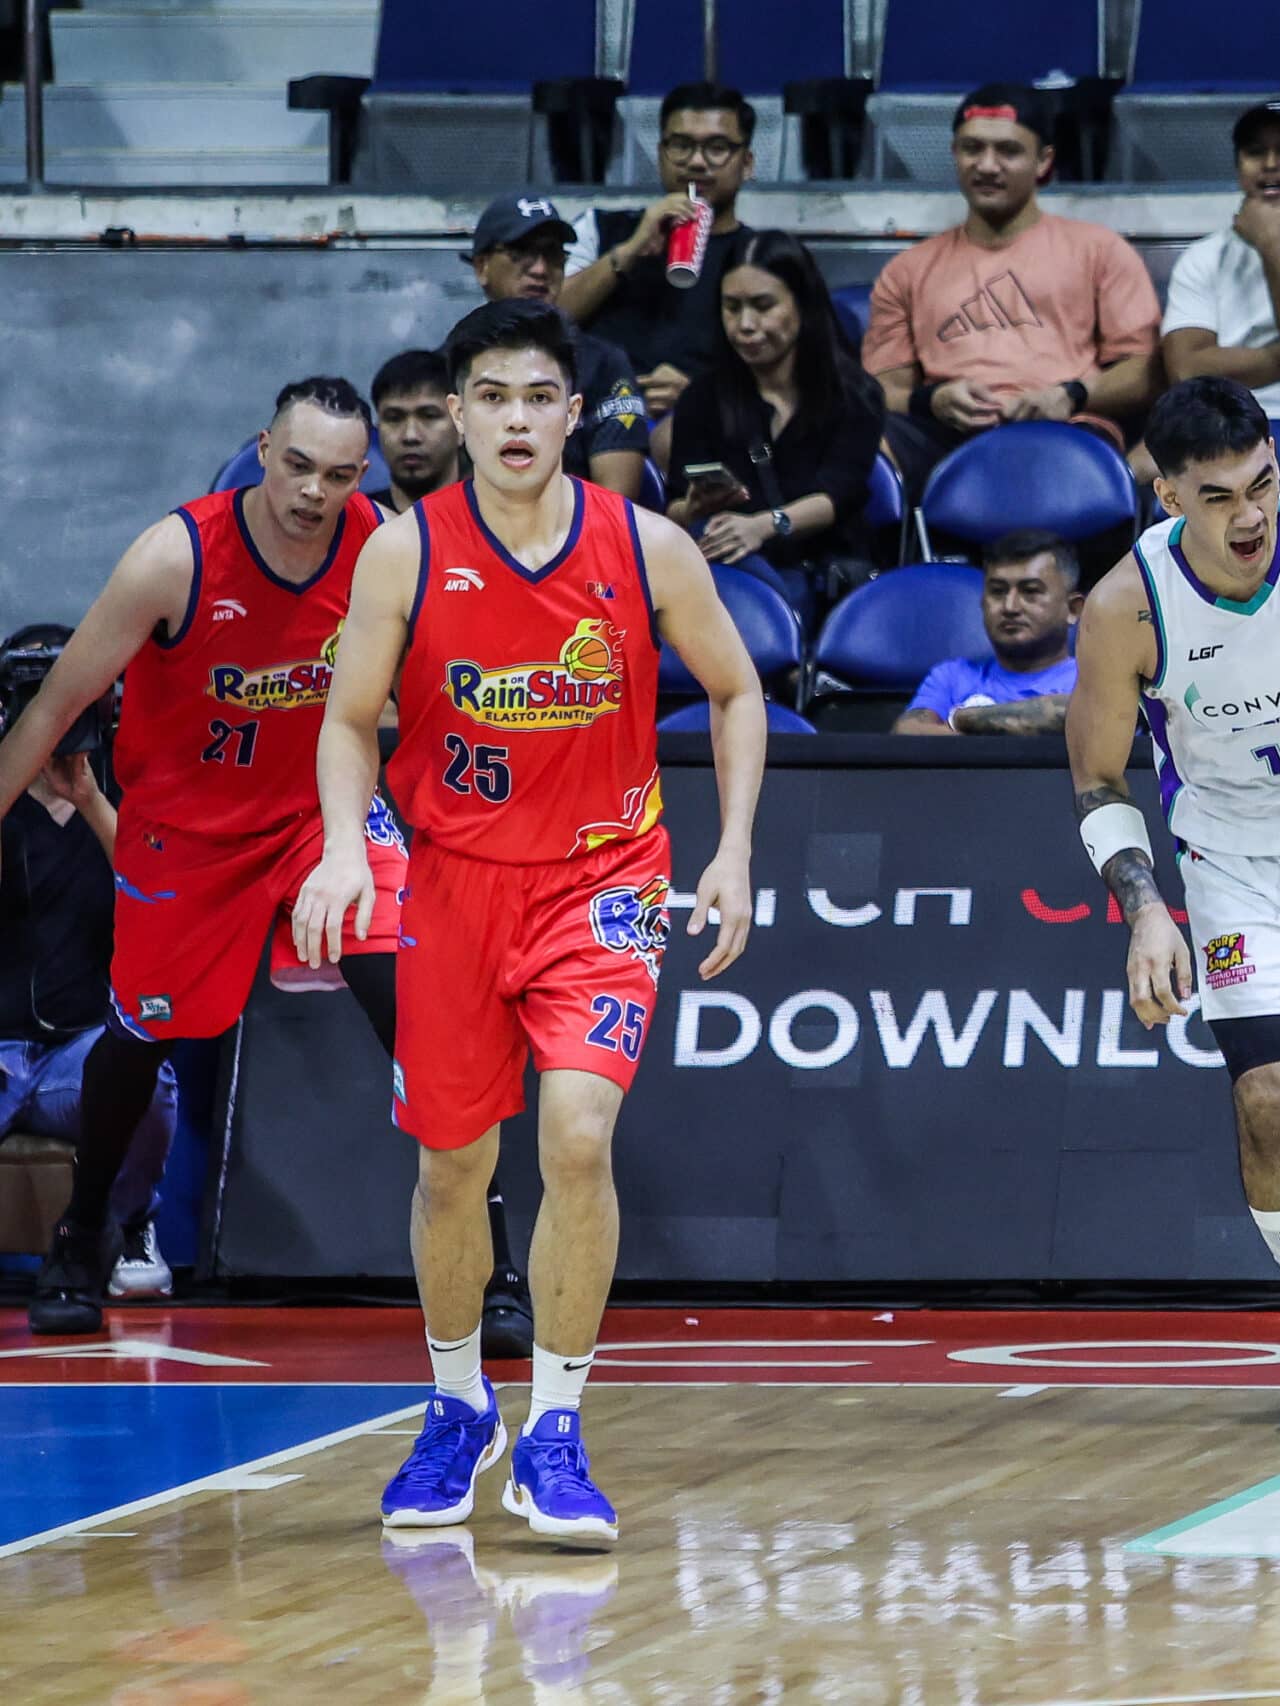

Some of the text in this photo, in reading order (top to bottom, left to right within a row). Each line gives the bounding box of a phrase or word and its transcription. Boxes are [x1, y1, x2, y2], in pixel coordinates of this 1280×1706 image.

[443, 580, 469, 592] ANTA
[212, 610, 234, 621] ANTA
[213, 667, 286, 700] Rain
[448, 664, 527, 711] Rain
[485, 709, 597, 722] ELASTO PAINTR
[201, 719, 259, 767] 21
[442, 733, 511, 803] 25
[585, 993, 646, 1061] 25
